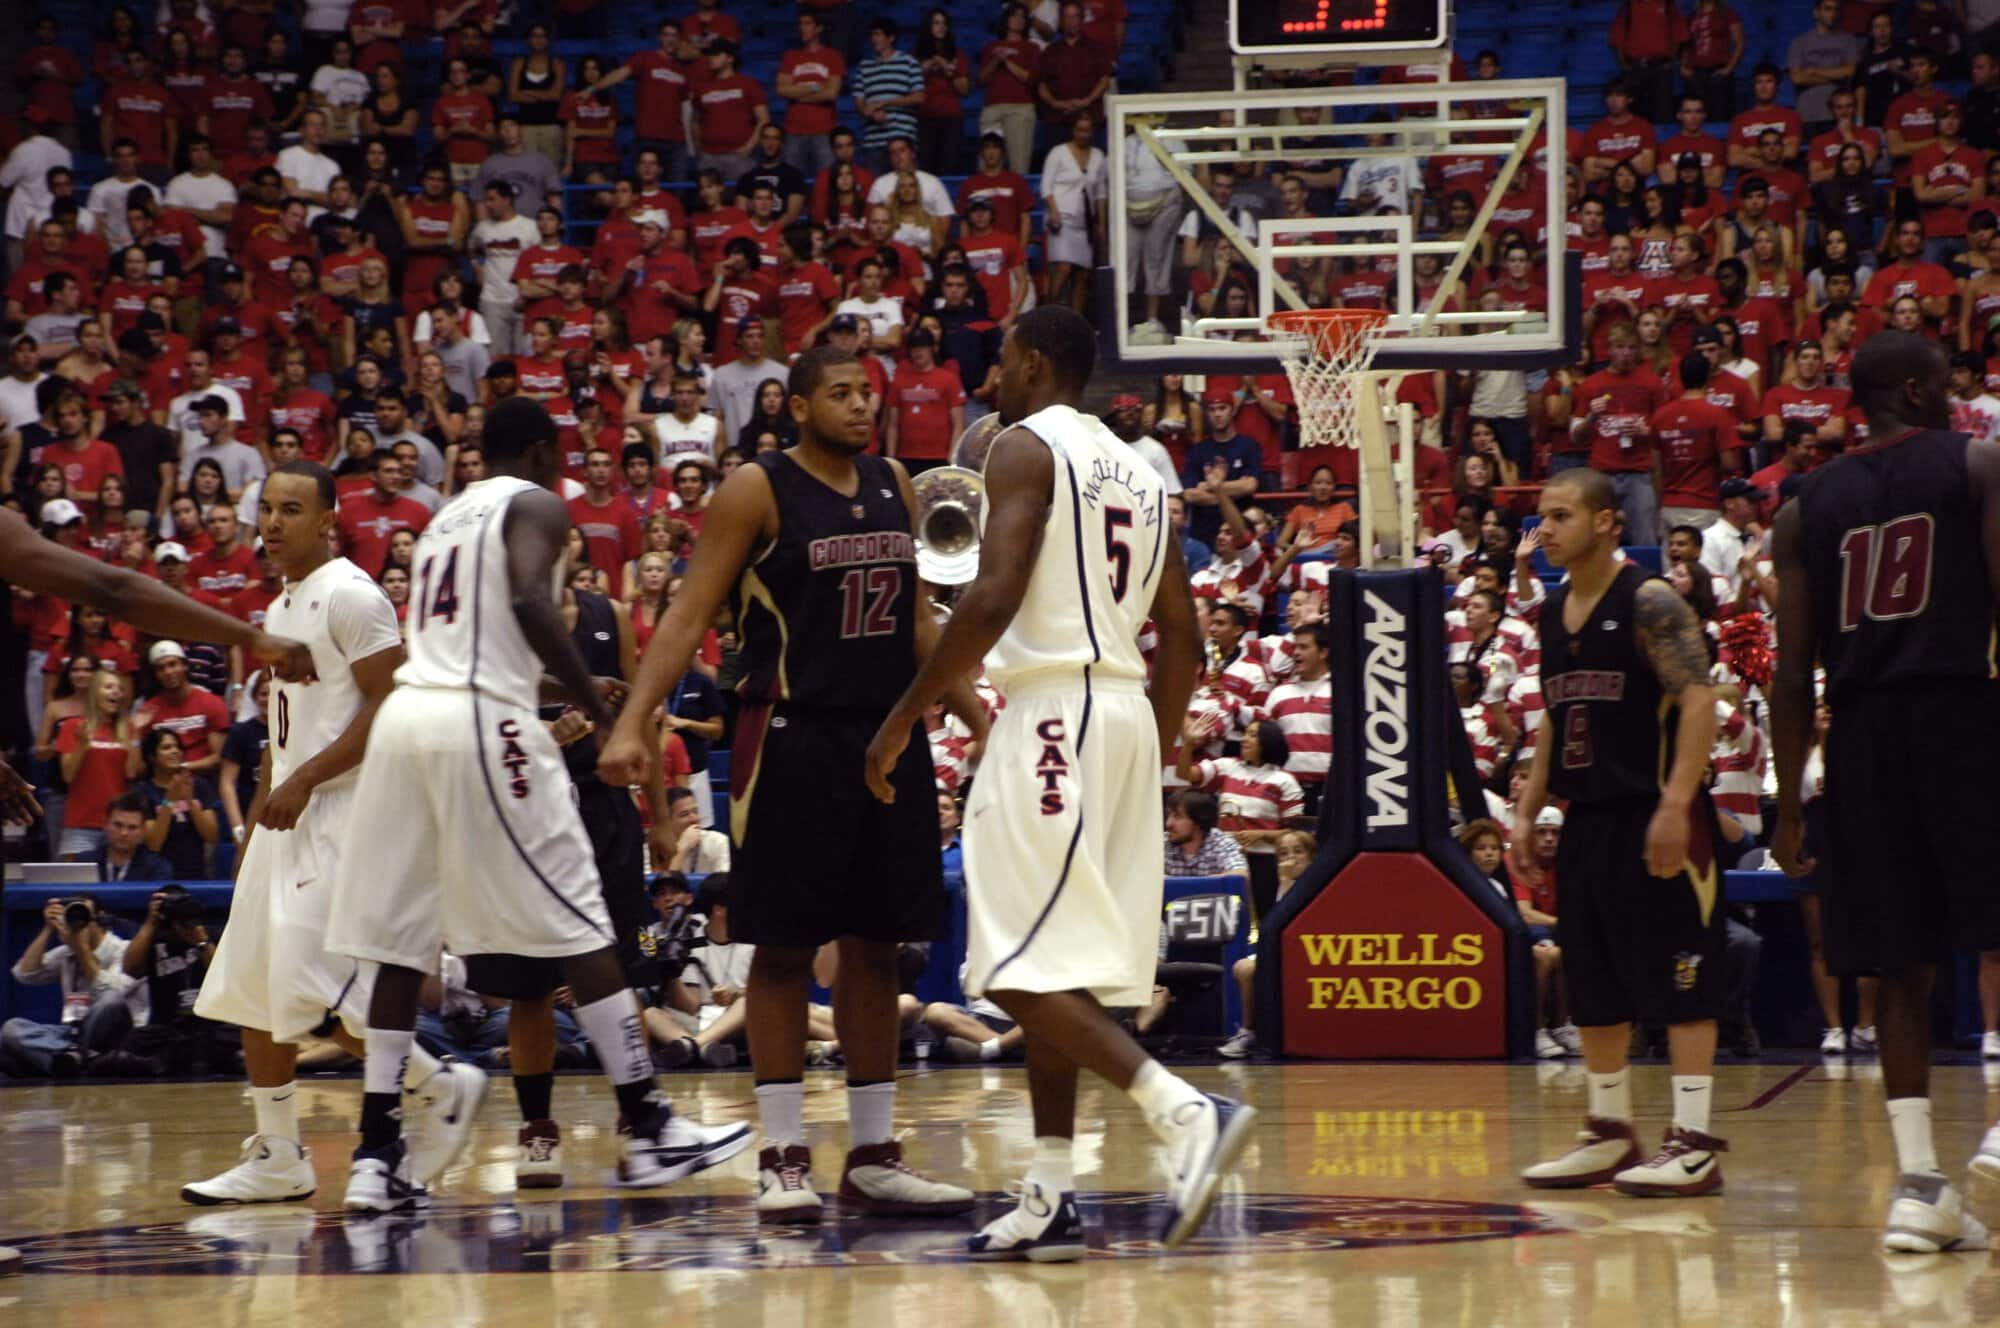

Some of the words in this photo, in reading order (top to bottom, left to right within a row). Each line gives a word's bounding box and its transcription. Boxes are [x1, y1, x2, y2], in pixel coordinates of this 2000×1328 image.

[417, 543, 462, 632] 14
[1104, 504, 1133, 605] 5
[838, 566, 901, 640] 12
[277, 688, 290, 749] 0
[1363, 589, 1409, 829] ARIZONA
[499, 719, 531, 799] CATS
[1036, 718, 1069, 815] CATS
[1167, 895, 1241, 939] FSN
[1300, 933, 1484, 966] WELLS
[1308, 976, 1482, 1010] FARGO
